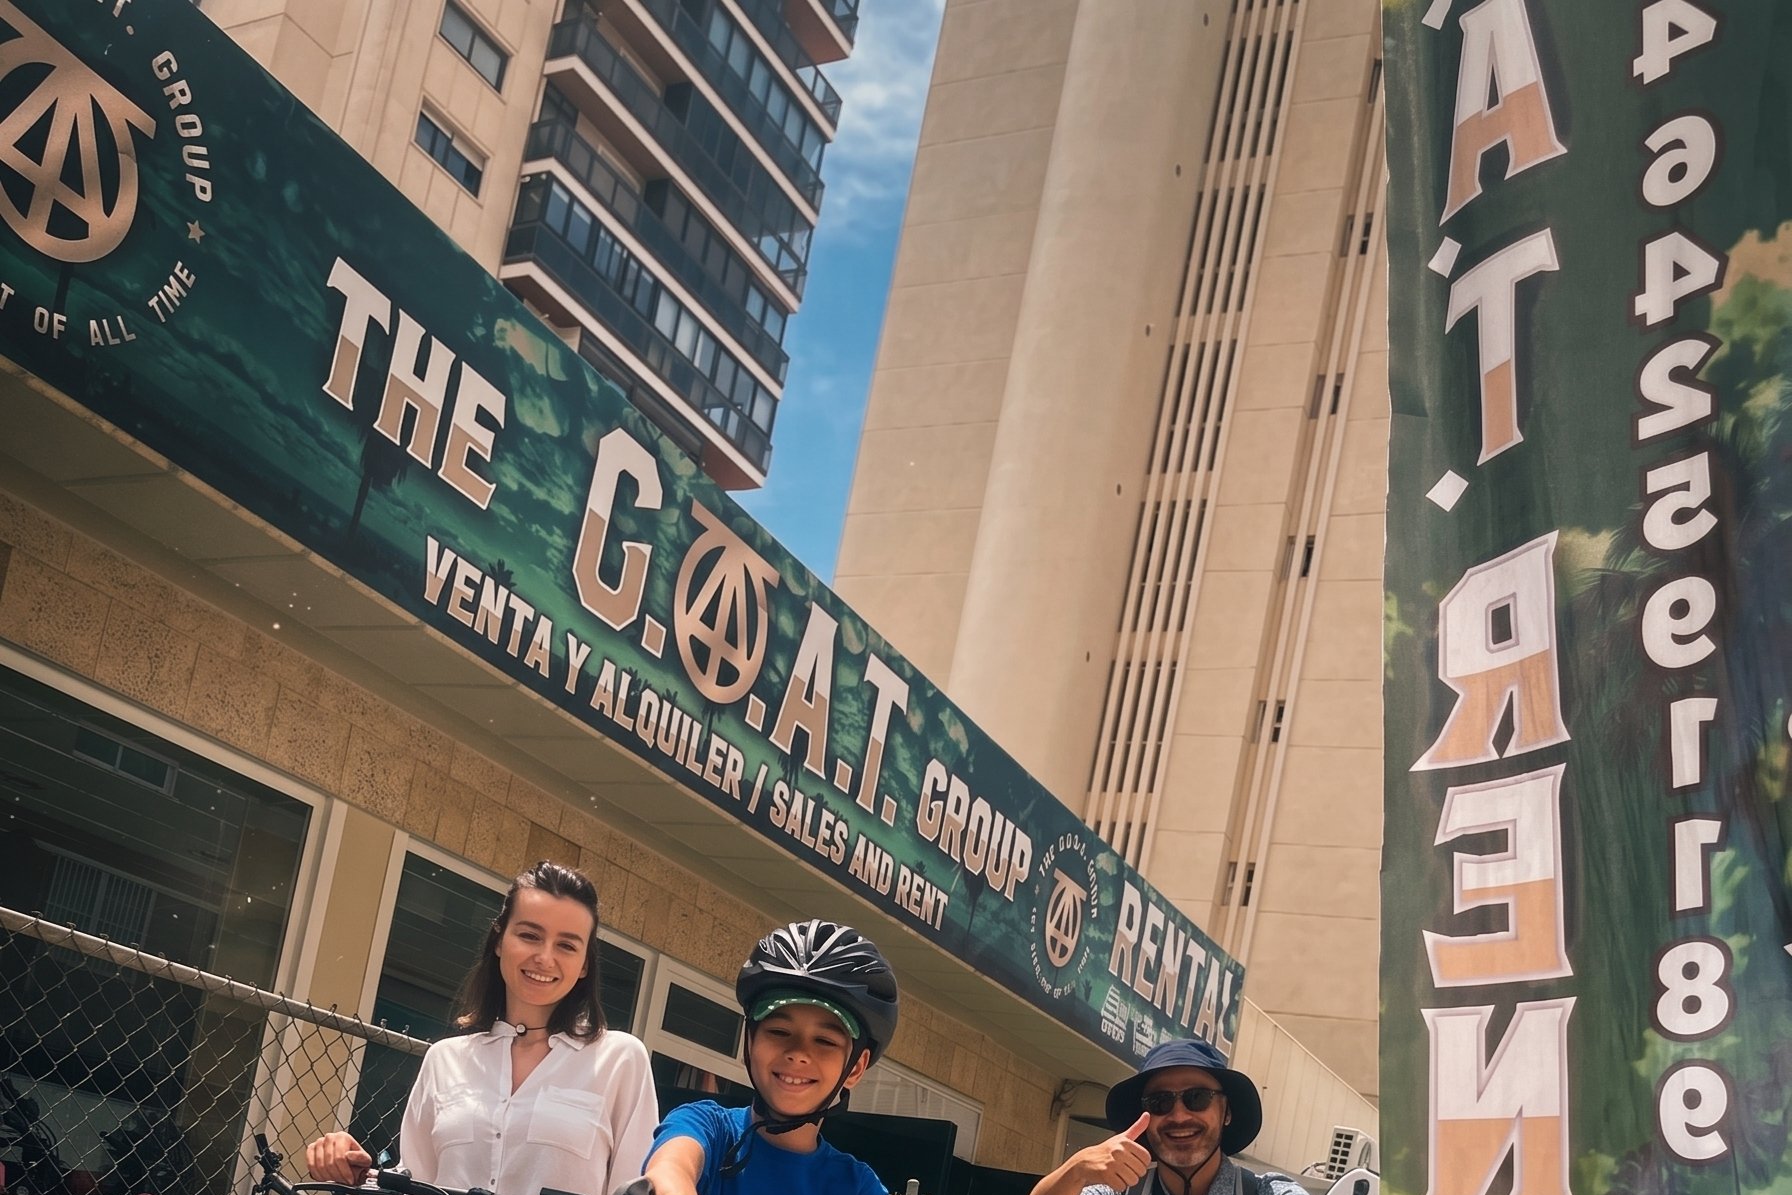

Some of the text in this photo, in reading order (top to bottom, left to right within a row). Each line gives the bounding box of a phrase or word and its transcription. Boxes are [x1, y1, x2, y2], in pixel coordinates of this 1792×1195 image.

[151, 50, 213, 203] GROUP
[33, 260, 197, 346] OF ALL TIME
[322, 256, 506, 510] THE
[916, 758, 1033, 902] GROUP
[1108, 880, 1234, 1058] RENTAL
[423, 535, 553, 679] VENTA
[562, 633, 591, 695] Y
[591, 659, 745, 800] ALQUILER
[770, 780, 849, 865] SALES
[849, 834, 895, 897] AND
[896, 861, 949, 931] RENT
